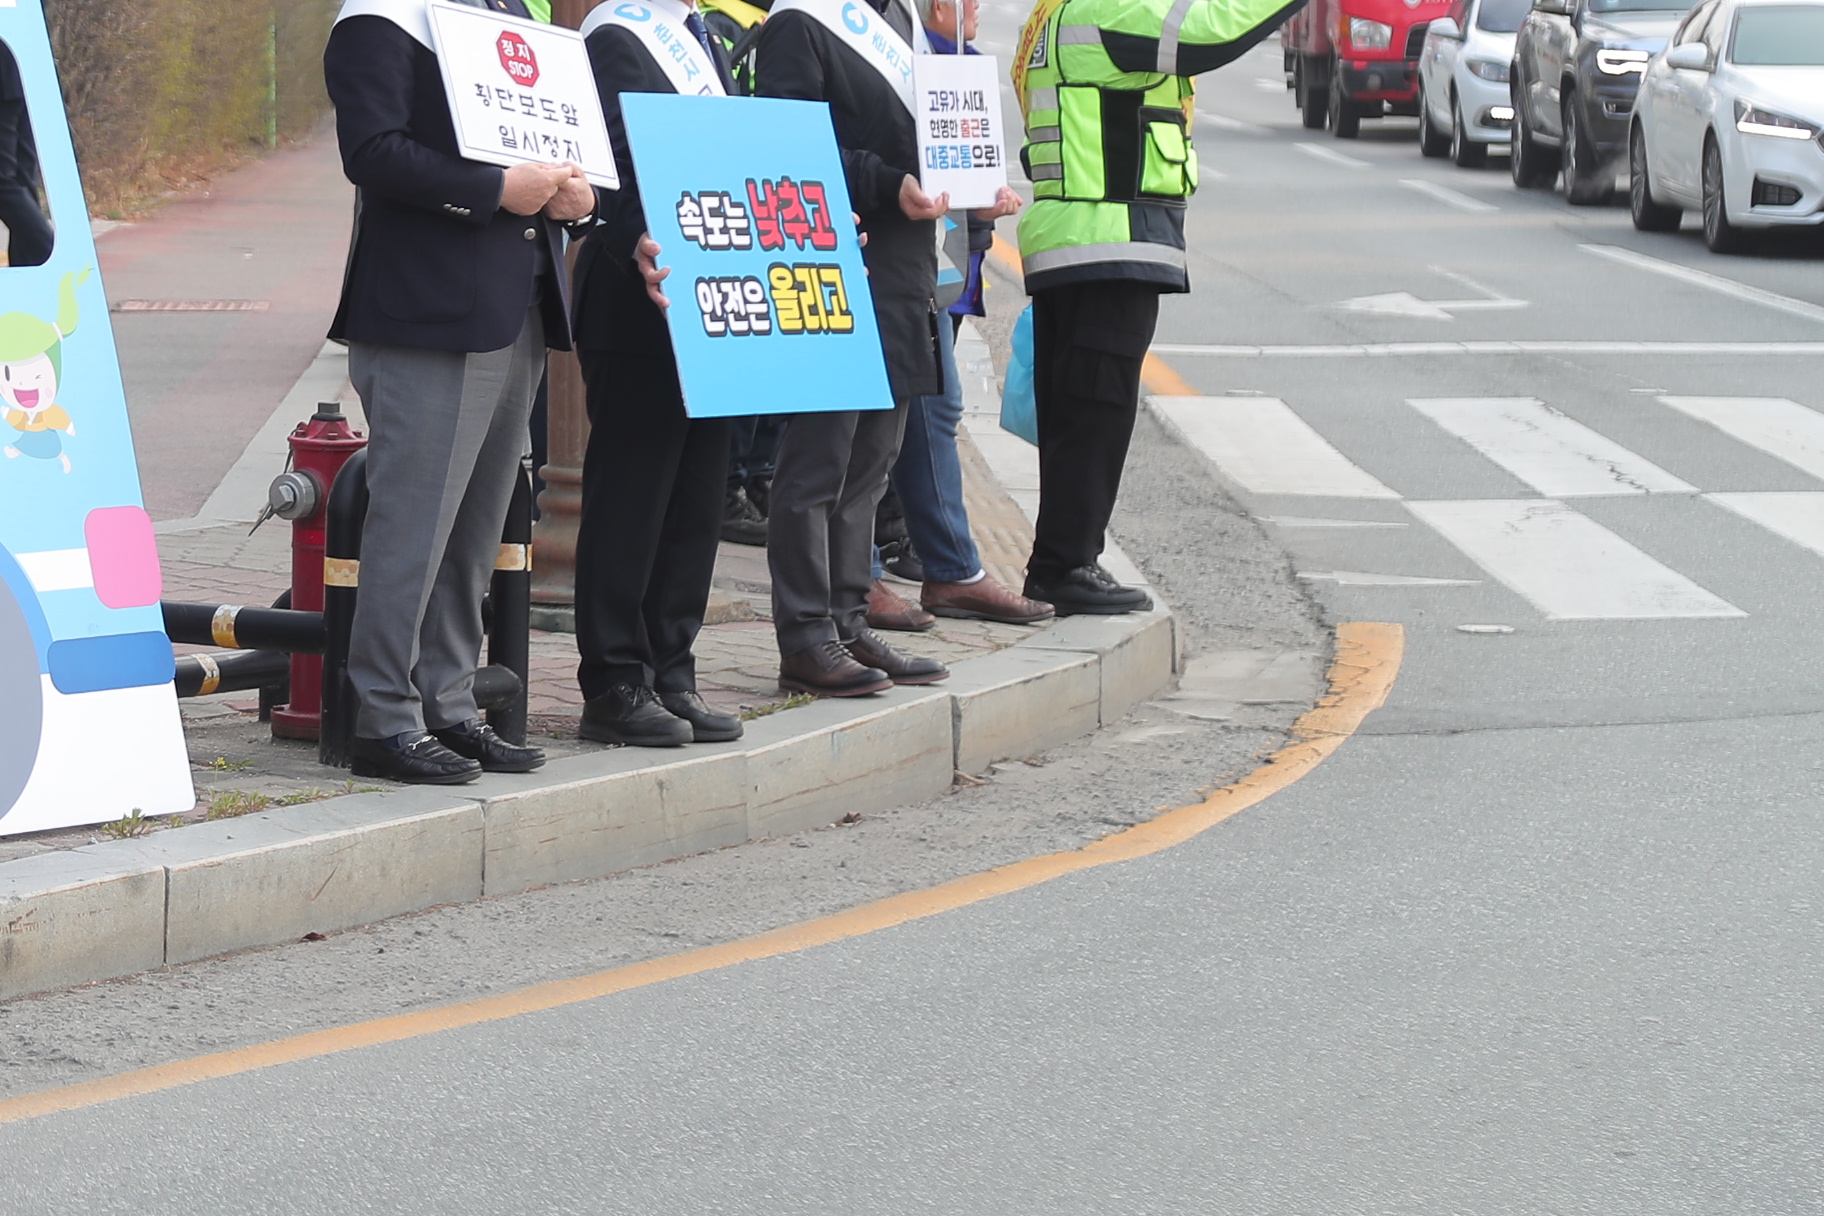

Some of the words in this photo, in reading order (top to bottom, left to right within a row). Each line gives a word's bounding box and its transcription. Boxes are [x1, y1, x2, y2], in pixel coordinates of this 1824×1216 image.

[508, 60, 534, 79] STOP
[654, 23, 700, 82] 춘천시
[872, 32, 913, 84] 춘천시
[928, 90, 960, 112] 고유가
[962, 90, 988, 114] 시대,
[930, 118, 958, 138] 현명한
[960, 118, 990, 138] 출근은
[925, 145, 1000, 170] 대중교통으로!
[677, 190, 752, 253] 속도는
[747, 176, 837, 251] 낮추고
[696, 277, 771, 335] 안전은
[768, 262, 853, 337] 올리고
